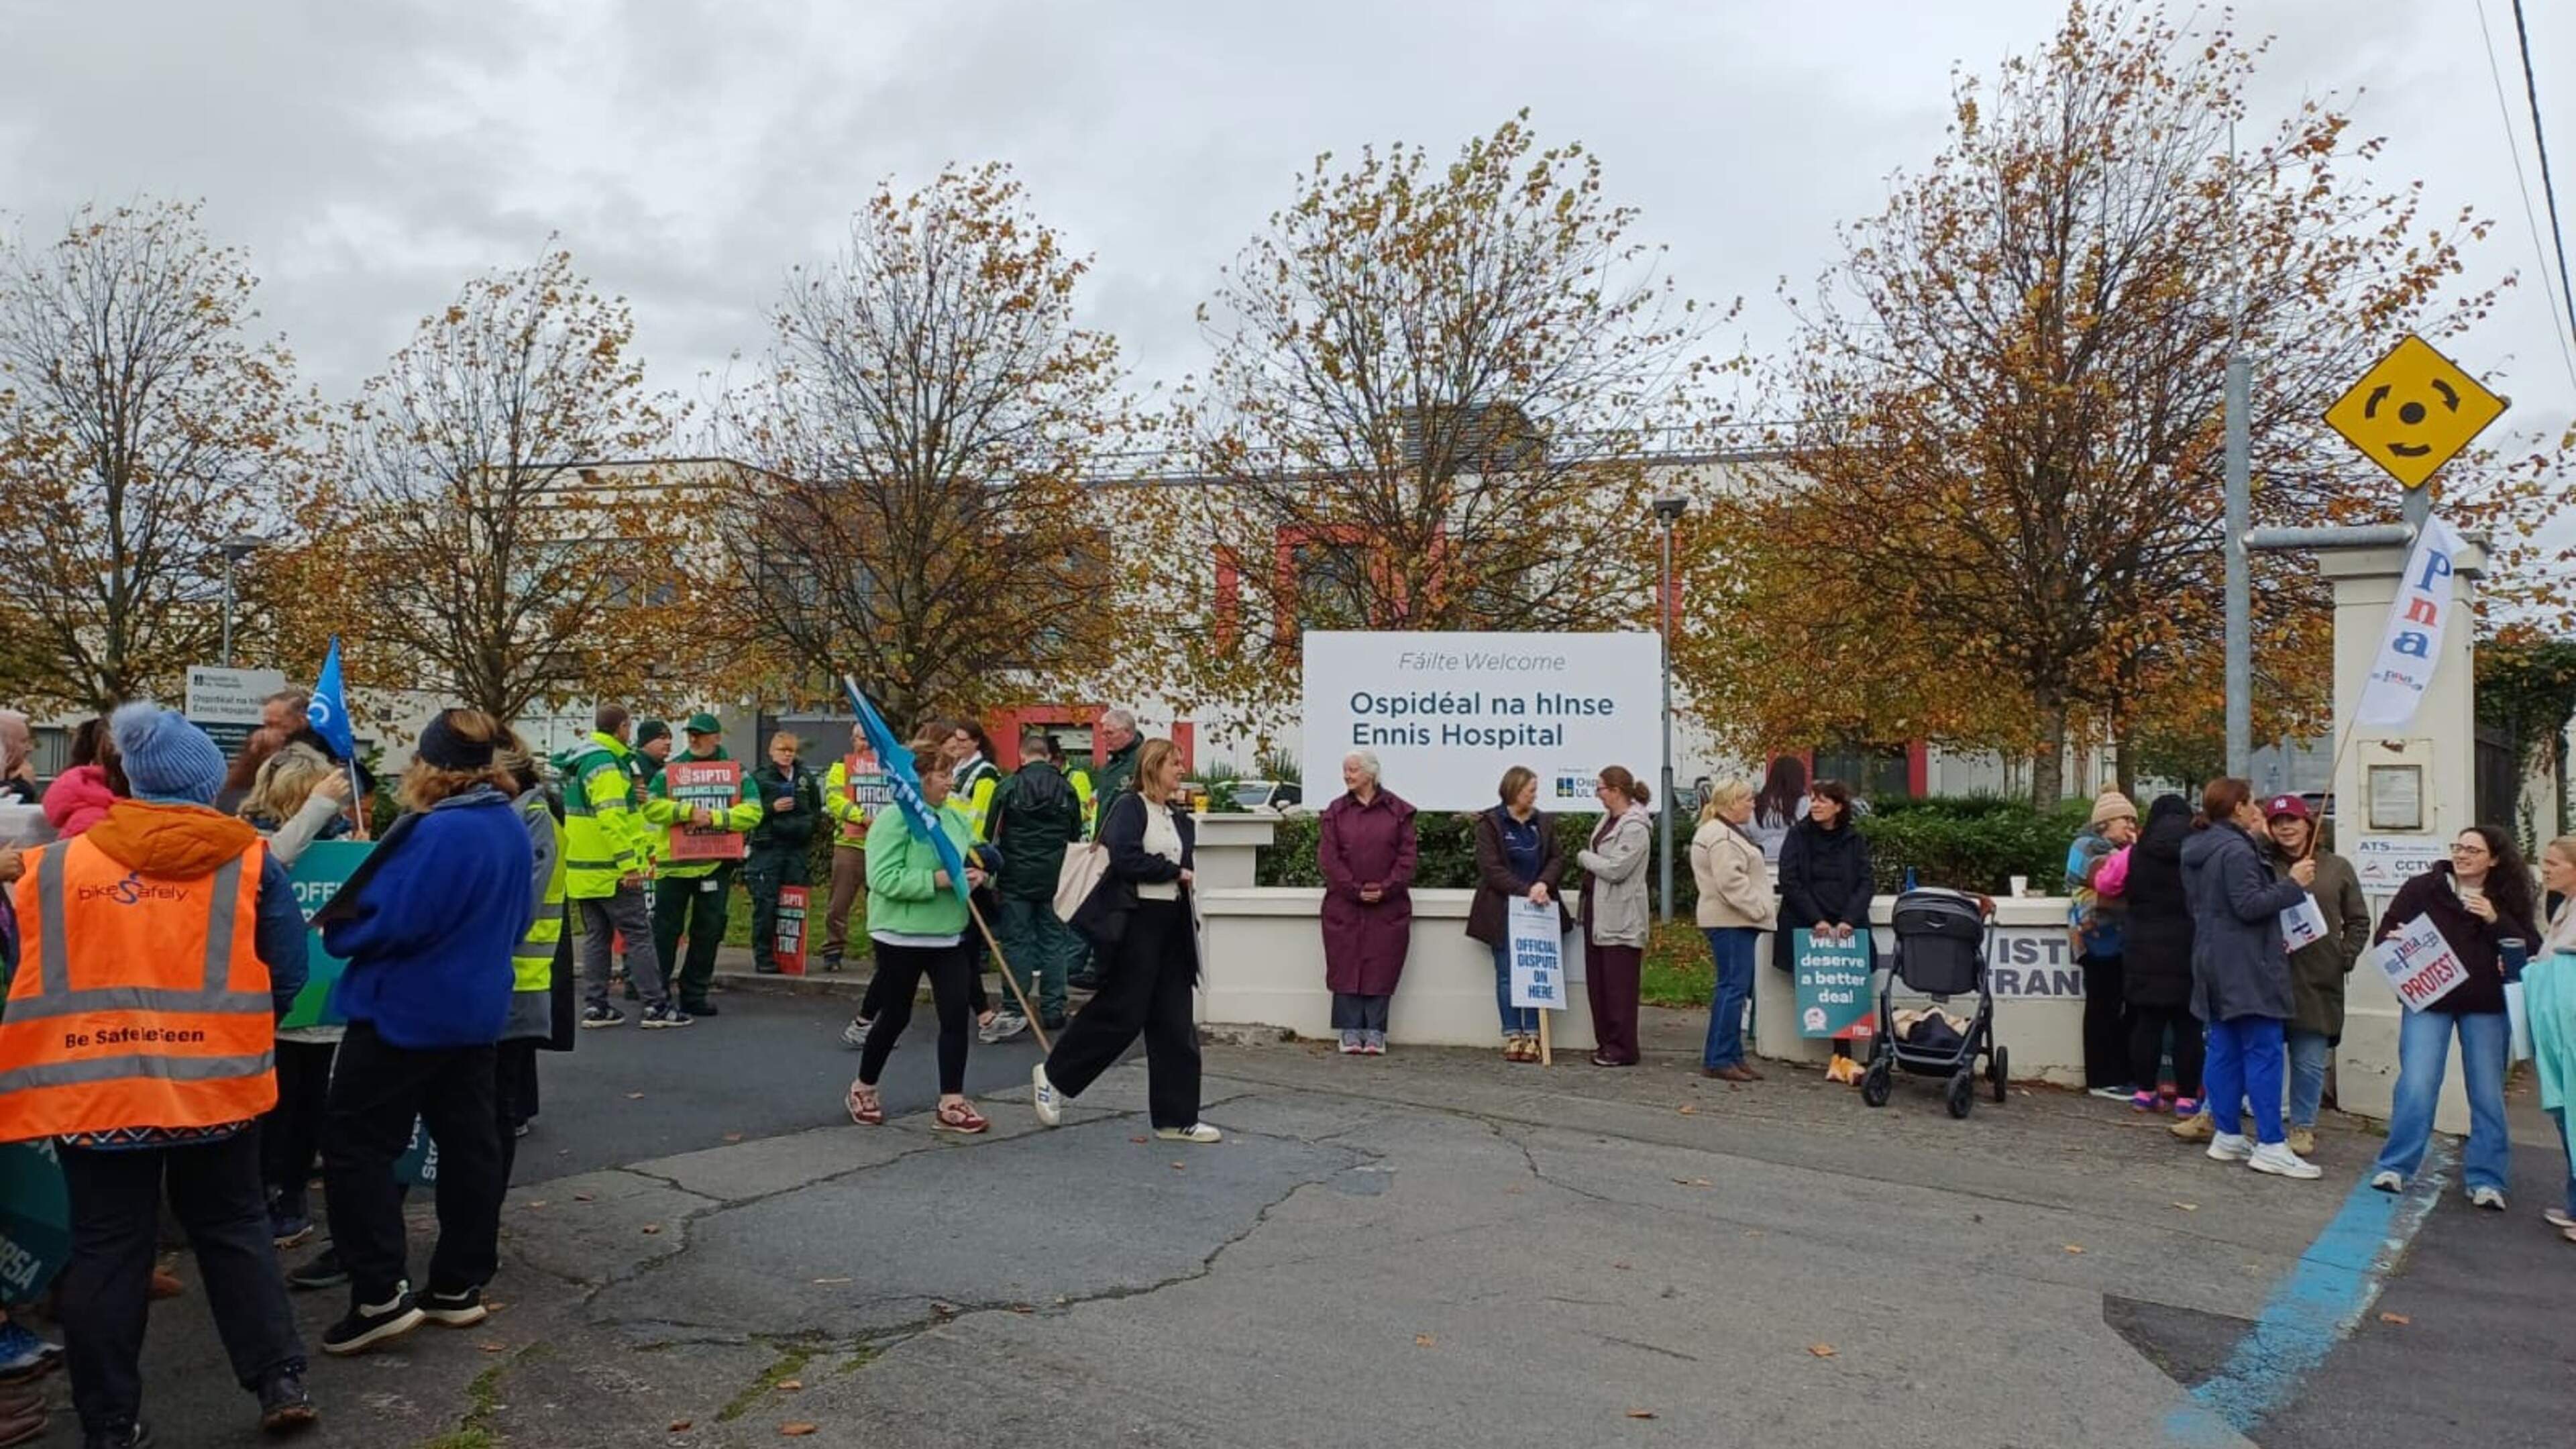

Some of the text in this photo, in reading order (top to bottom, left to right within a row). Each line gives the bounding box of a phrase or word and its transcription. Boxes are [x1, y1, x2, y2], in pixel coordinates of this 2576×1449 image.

[1398, 651, 1566, 671] Fáilte Welcome
[1350, 691, 1615, 718] Ospidéal na hInse
[1352, 722, 1563, 750] Ennis Hospital
[692, 769, 732, 782] SIPTU
[2360, 842, 2390, 851] ATS
[2394, 860, 2434, 871] CCTV
[1515, 938, 1557, 954] OFFICIAL
[1808, 934, 1856, 949] We all
[1517, 953, 1558, 969] DISPUTE
[1800, 953, 1866, 968] deserve
[1534, 970, 1548, 983] ON
[1801, 970, 1866, 986] a better
[1987, 969, 2080, 996] RAN
[2400, 952, 2459, 1004] PROTEST
[1527, 985, 1554, 999] HERE
[1818, 989, 1854, 1004] deal
[65, 1032, 89, 1049] Be
[95, 1027, 140, 1044] Safe
